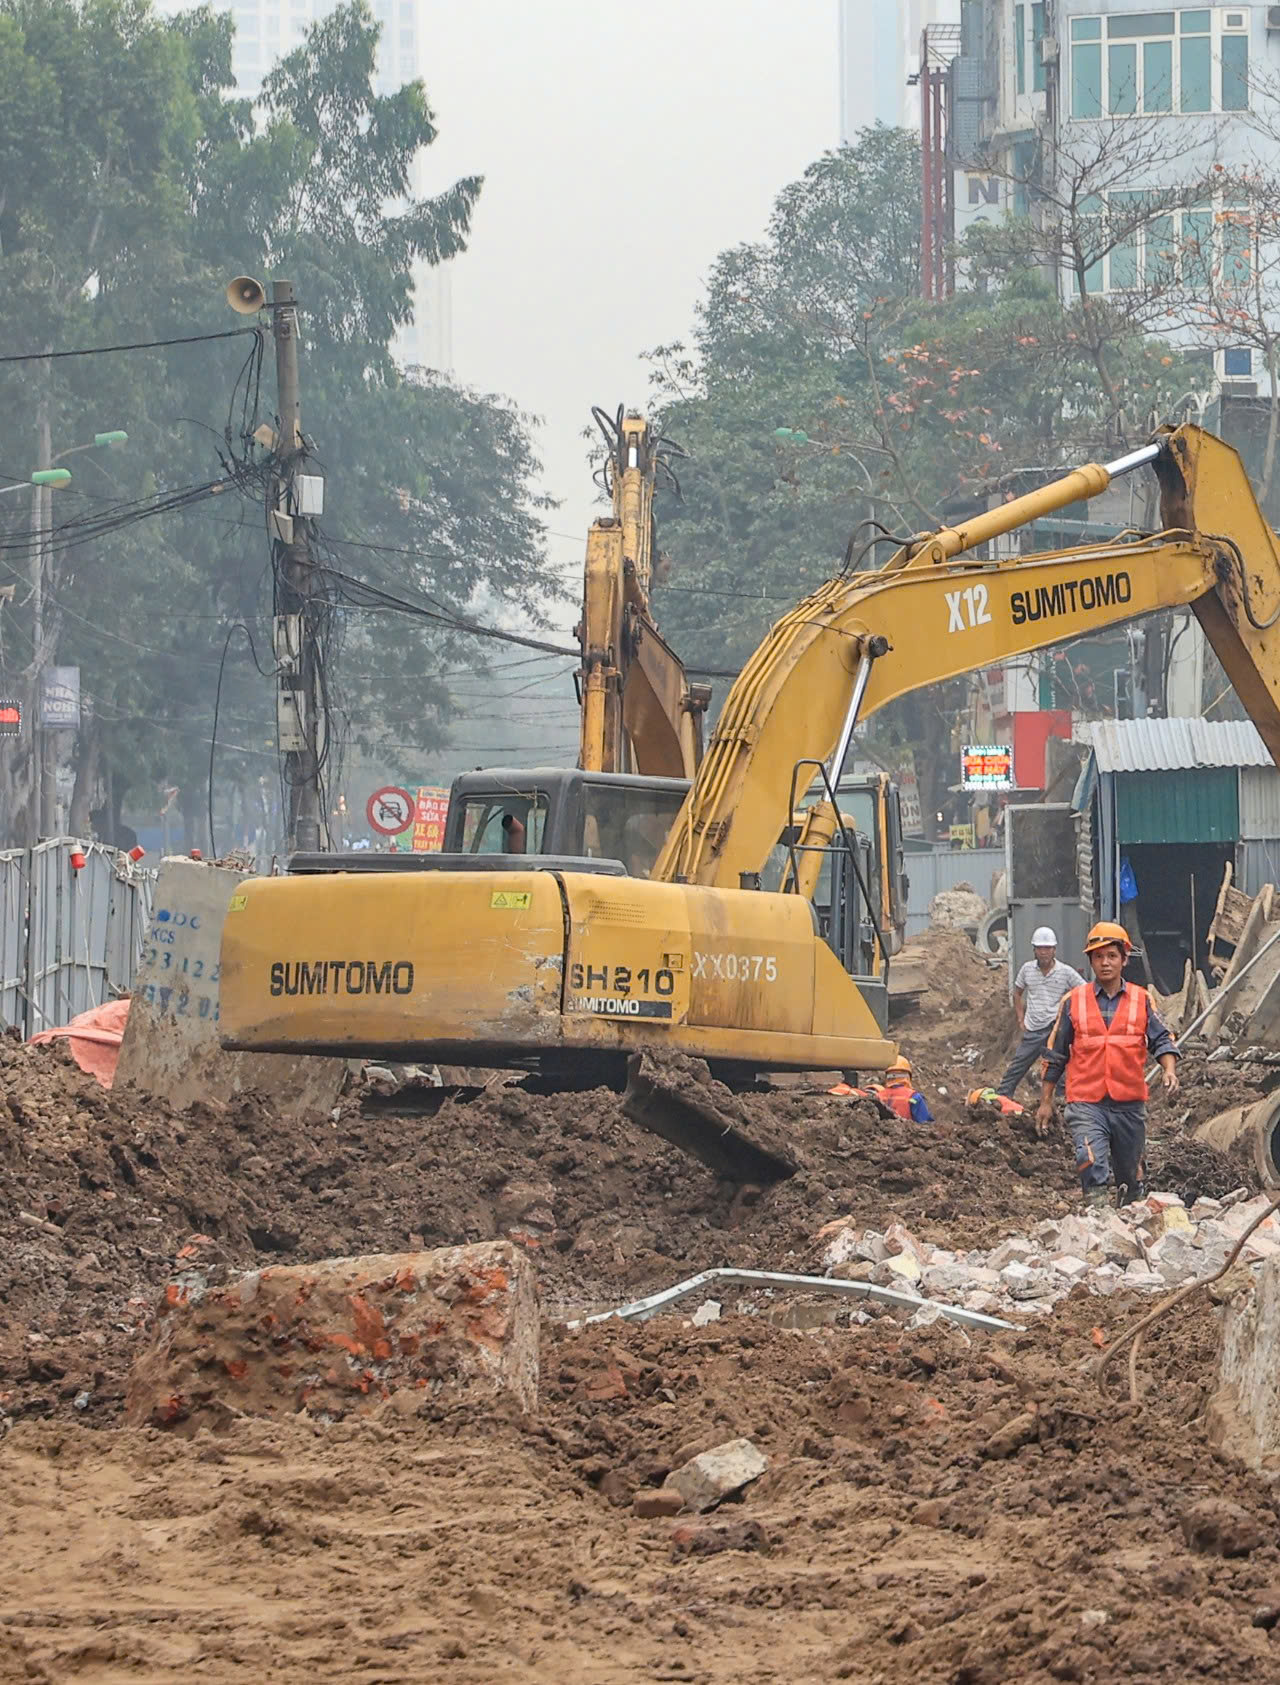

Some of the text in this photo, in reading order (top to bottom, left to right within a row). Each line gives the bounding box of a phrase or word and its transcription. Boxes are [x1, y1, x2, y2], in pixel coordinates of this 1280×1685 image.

[944, 583, 992, 633] X12
[1010, 571, 1131, 625] SUMITOMO
[151, 927, 176, 944] KCS
[270, 960, 414, 997] SUMITOMO
[692, 951, 777, 982] XX0375
